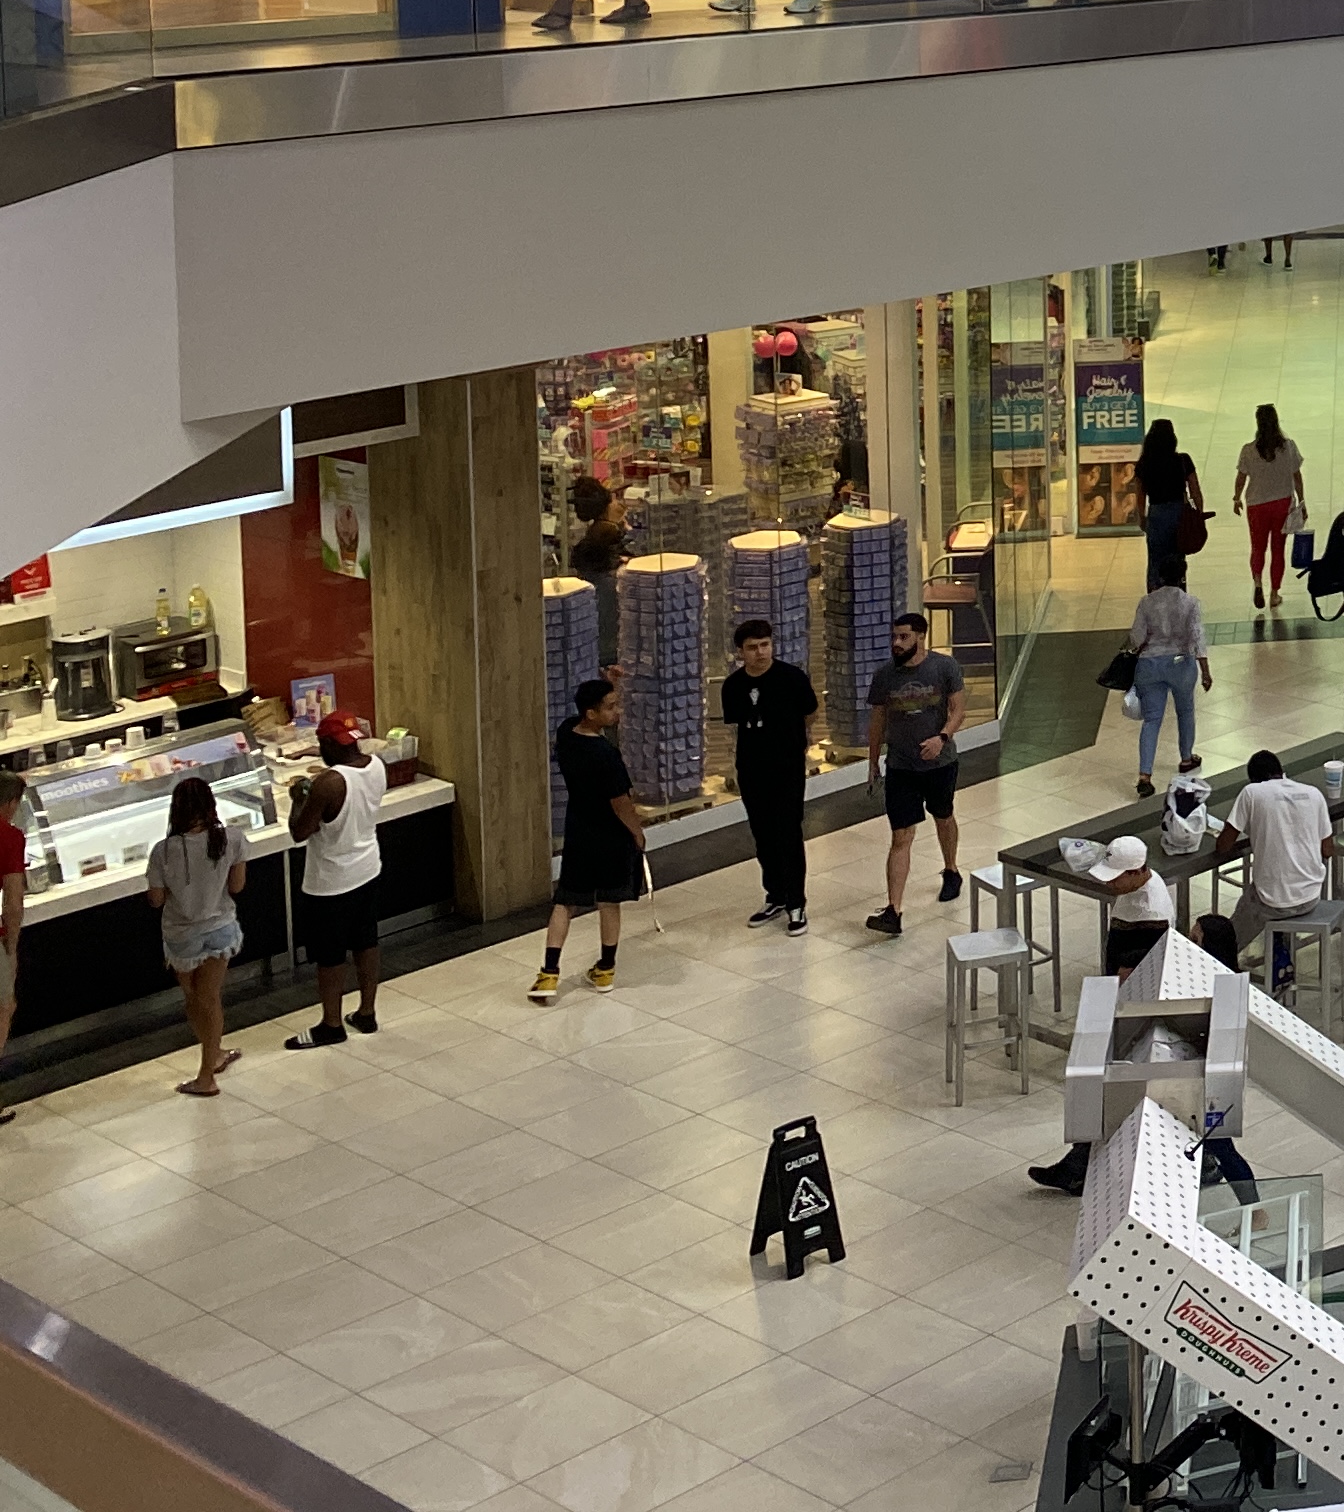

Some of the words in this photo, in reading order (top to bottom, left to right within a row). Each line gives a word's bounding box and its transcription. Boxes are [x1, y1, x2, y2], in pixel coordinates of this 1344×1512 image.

[1082, 409, 1138, 430] FREE
[785, 1151, 819, 1172] CAUTION
[1173, 1298, 1232, 1345] Krispy
[1219, 1330, 1278, 1373] Kreme
[1180, 1330, 1241, 1374] DOUGHNUTS
